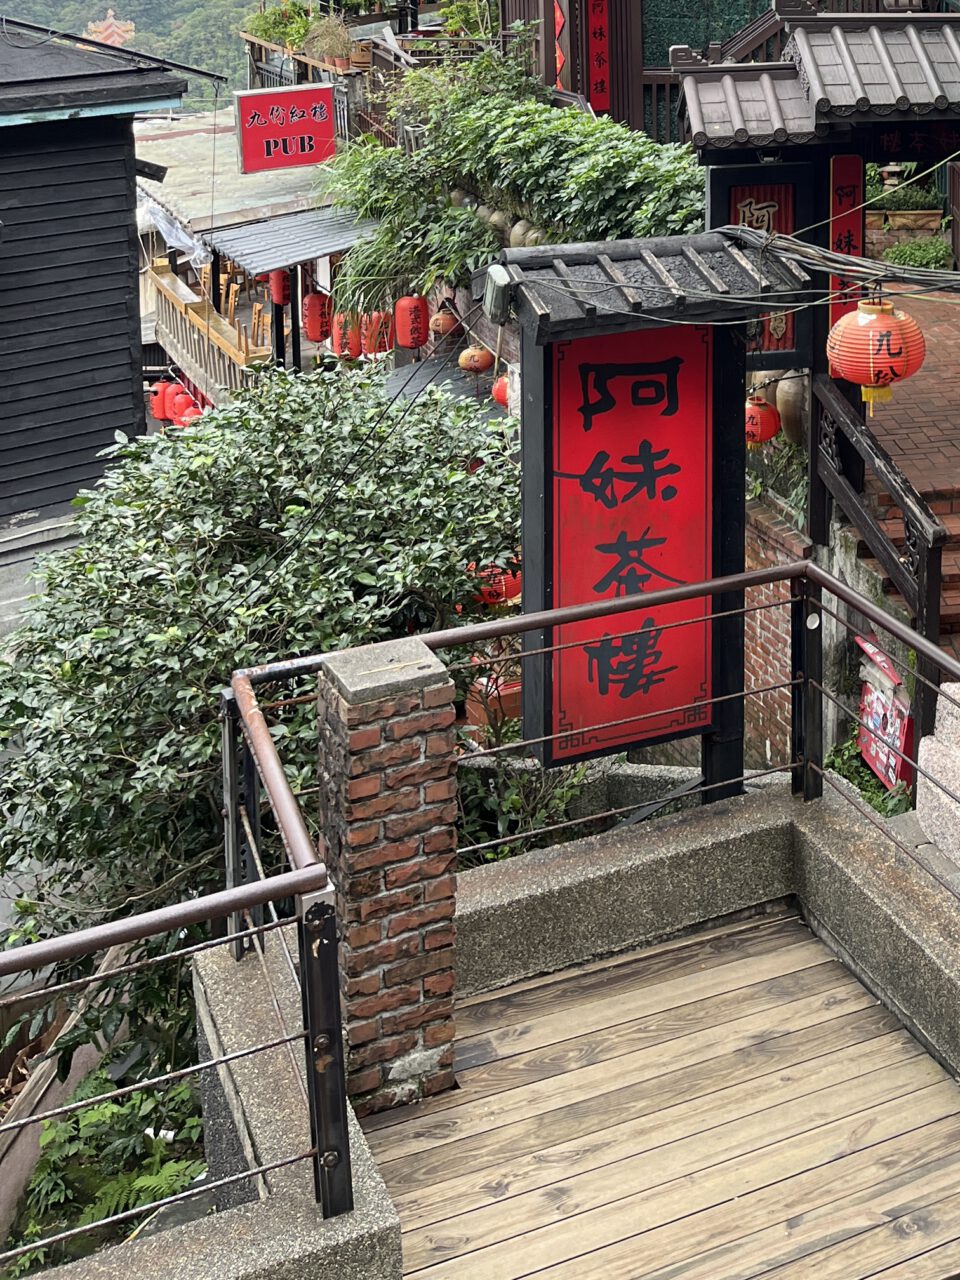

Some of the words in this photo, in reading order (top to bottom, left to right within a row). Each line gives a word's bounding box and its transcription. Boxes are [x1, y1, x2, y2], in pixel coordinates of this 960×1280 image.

[592, 0, 607, 94] 阿妹茶樓
[264, 135, 315, 158] PUB
[873, 330, 902, 384] 九份
[560, 356, 688, 699] 阿妹茶樓
